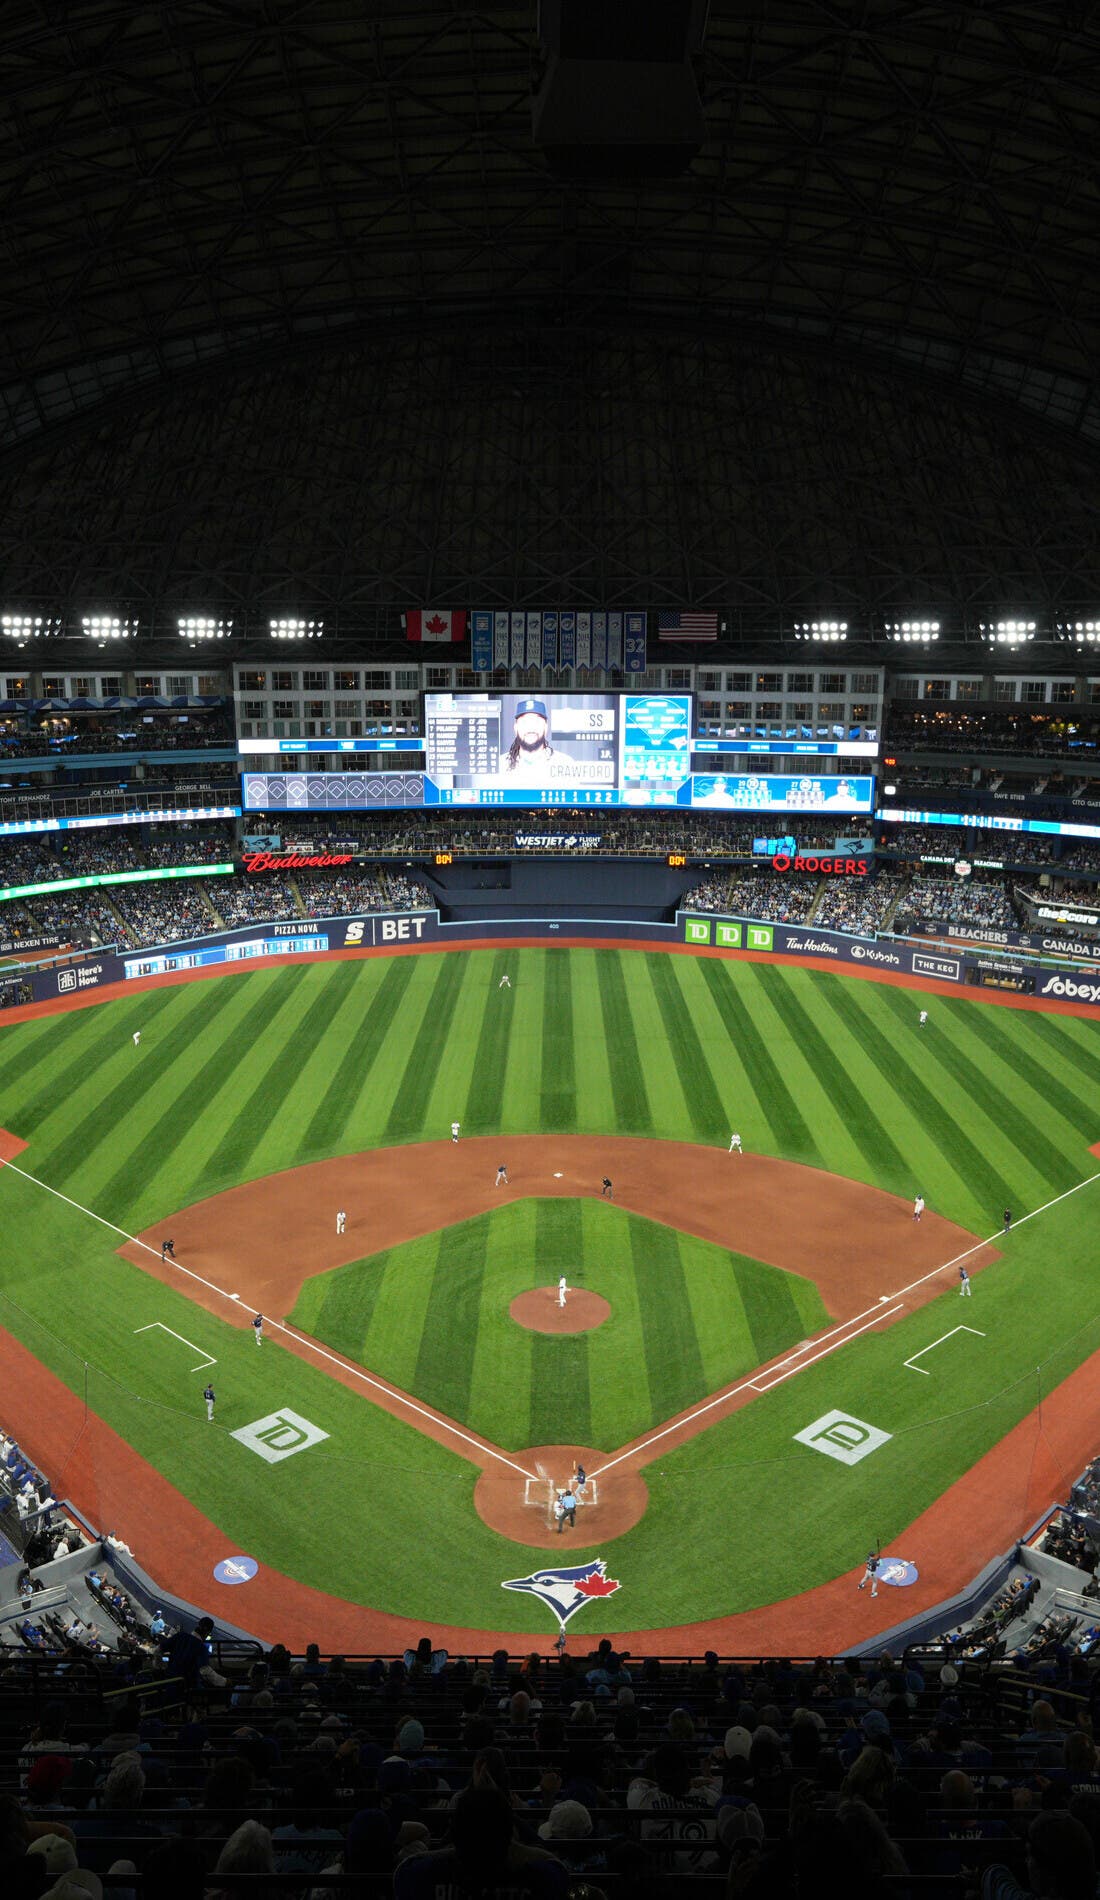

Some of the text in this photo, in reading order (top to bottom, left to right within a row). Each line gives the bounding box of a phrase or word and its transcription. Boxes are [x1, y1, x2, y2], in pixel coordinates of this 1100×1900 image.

[626, 638, 645, 653] 32
[589, 713, 603, 727] SS
[550, 764, 611, 778] CRAWFORD
[18, 794, 50, 802] FERNANDEZ
[595, 791, 602, 802] 2
[606, 791, 613, 802] 2
[1072, 799, 1086, 807] CITO
[515, 835, 564, 849] WESTJET
[242, 851, 352, 873] Budweiser
[793, 856, 868, 875] ROGERS
[1038, 907, 1098, 925] theScore
[274, 923, 318, 936] PIZZA NOVA
[382, 917, 426, 940] BET
[688, 923, 708, 939] TD
[719, 926, 739, 942] TD
[948, 926, 1008, 943] BLEACHERS
[14, 938, 40, 949] NEXEN
[41, 936, 59, 945] TIRE
[750, 930, 771, 945] TD
[786, 937, 838, 954] Tim Hortons
[1042, 939, 1089, 956] CANADA
[866, 949, 899, 965] Kubota
[78, 964, 103, 977] Here's
[918, 961, 954, 973] THE KEG
[78, 976, 99, 988] How.
[1041, 976, 1100, 1002] Sobey
[254, 1415, 309, 1451] TD
[809, 1420, 870, 1451] TD
